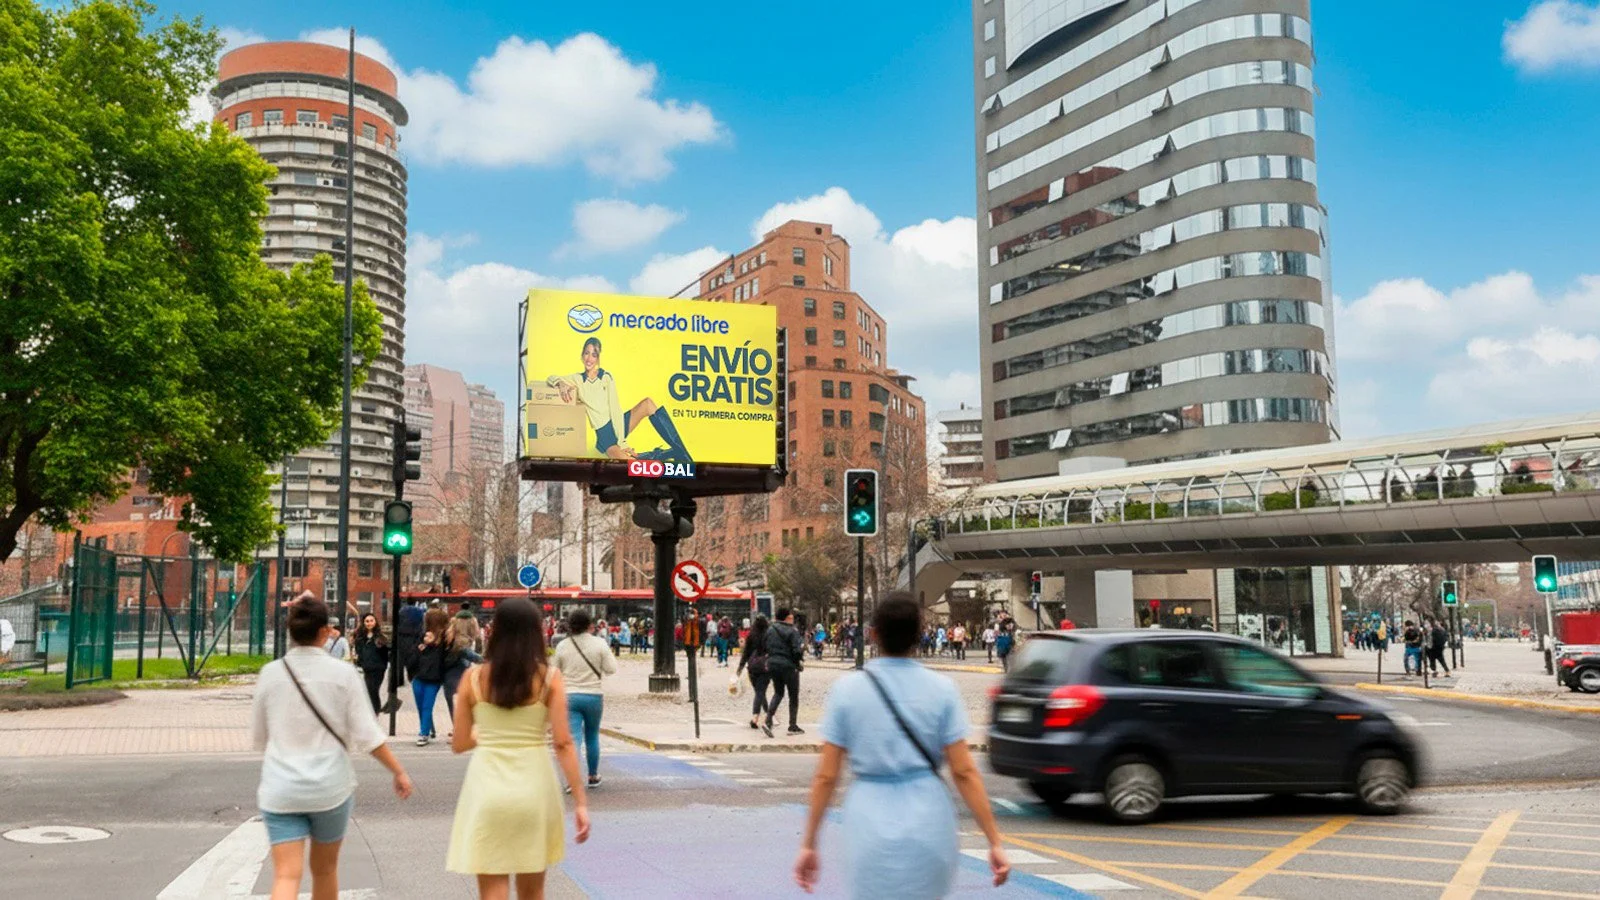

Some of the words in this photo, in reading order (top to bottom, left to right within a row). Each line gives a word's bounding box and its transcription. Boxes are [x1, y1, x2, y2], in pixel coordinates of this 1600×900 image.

[609, 313, 687, 331] mercado
[692, 315, 729, 334] libre
[681, 341, 772, 375] ENVÍO
[668, 373, 773, 405] GRATIS
[673, 409, 684, 418] EN
[686, 410, 697, 418] TU
[699, 409, 736, 420] PRIMERA
[738, 412, 773, 422] COMPRA
[630, 461, 694, 477] GLOBAL
